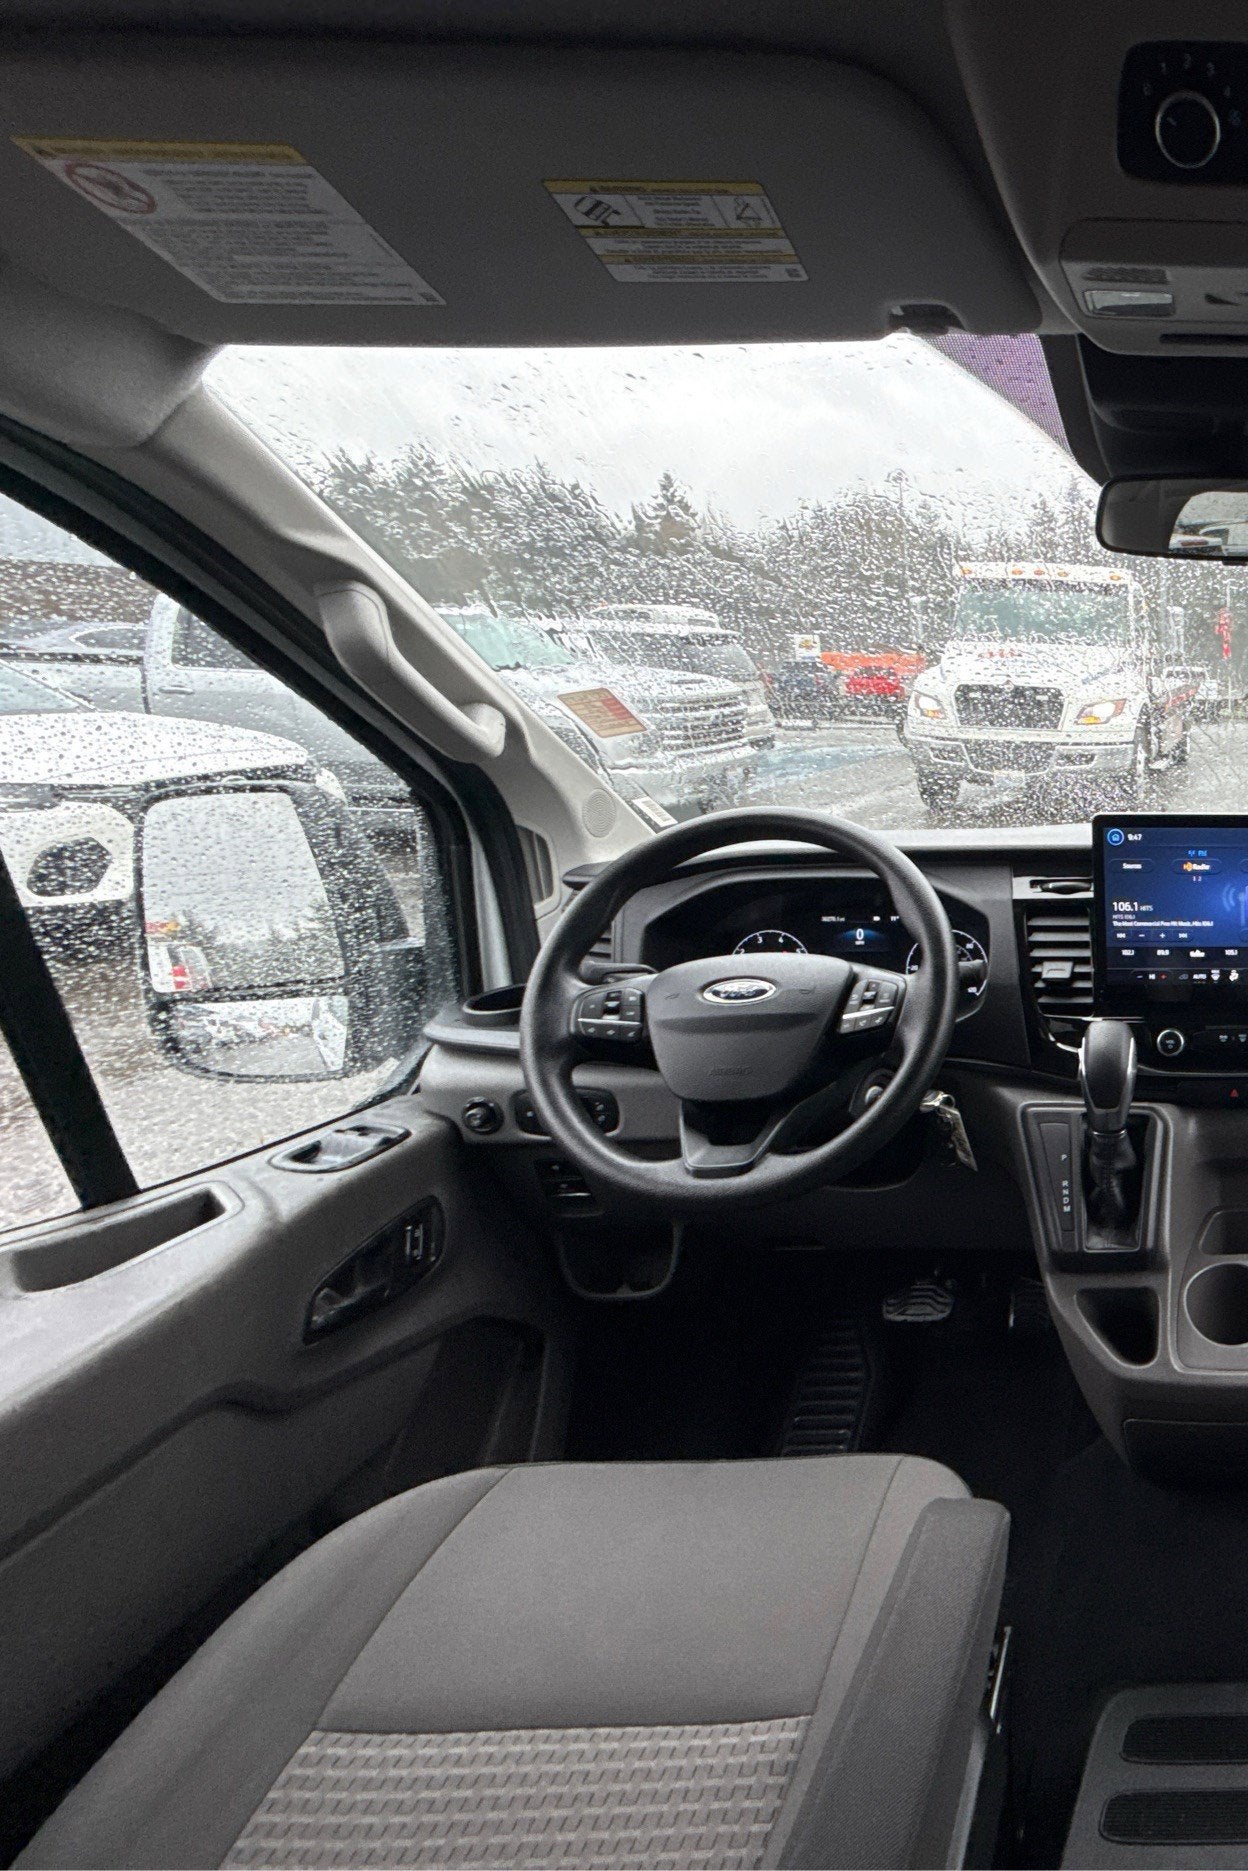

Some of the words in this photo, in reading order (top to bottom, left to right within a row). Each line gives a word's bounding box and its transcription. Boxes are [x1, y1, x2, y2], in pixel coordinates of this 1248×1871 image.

[1183, 54, 1192, 69] 2
[1112, 902, 1139, 912] 106.1
[856, 928, 864, 940] 0
[757, 936, 763, 944] 3
